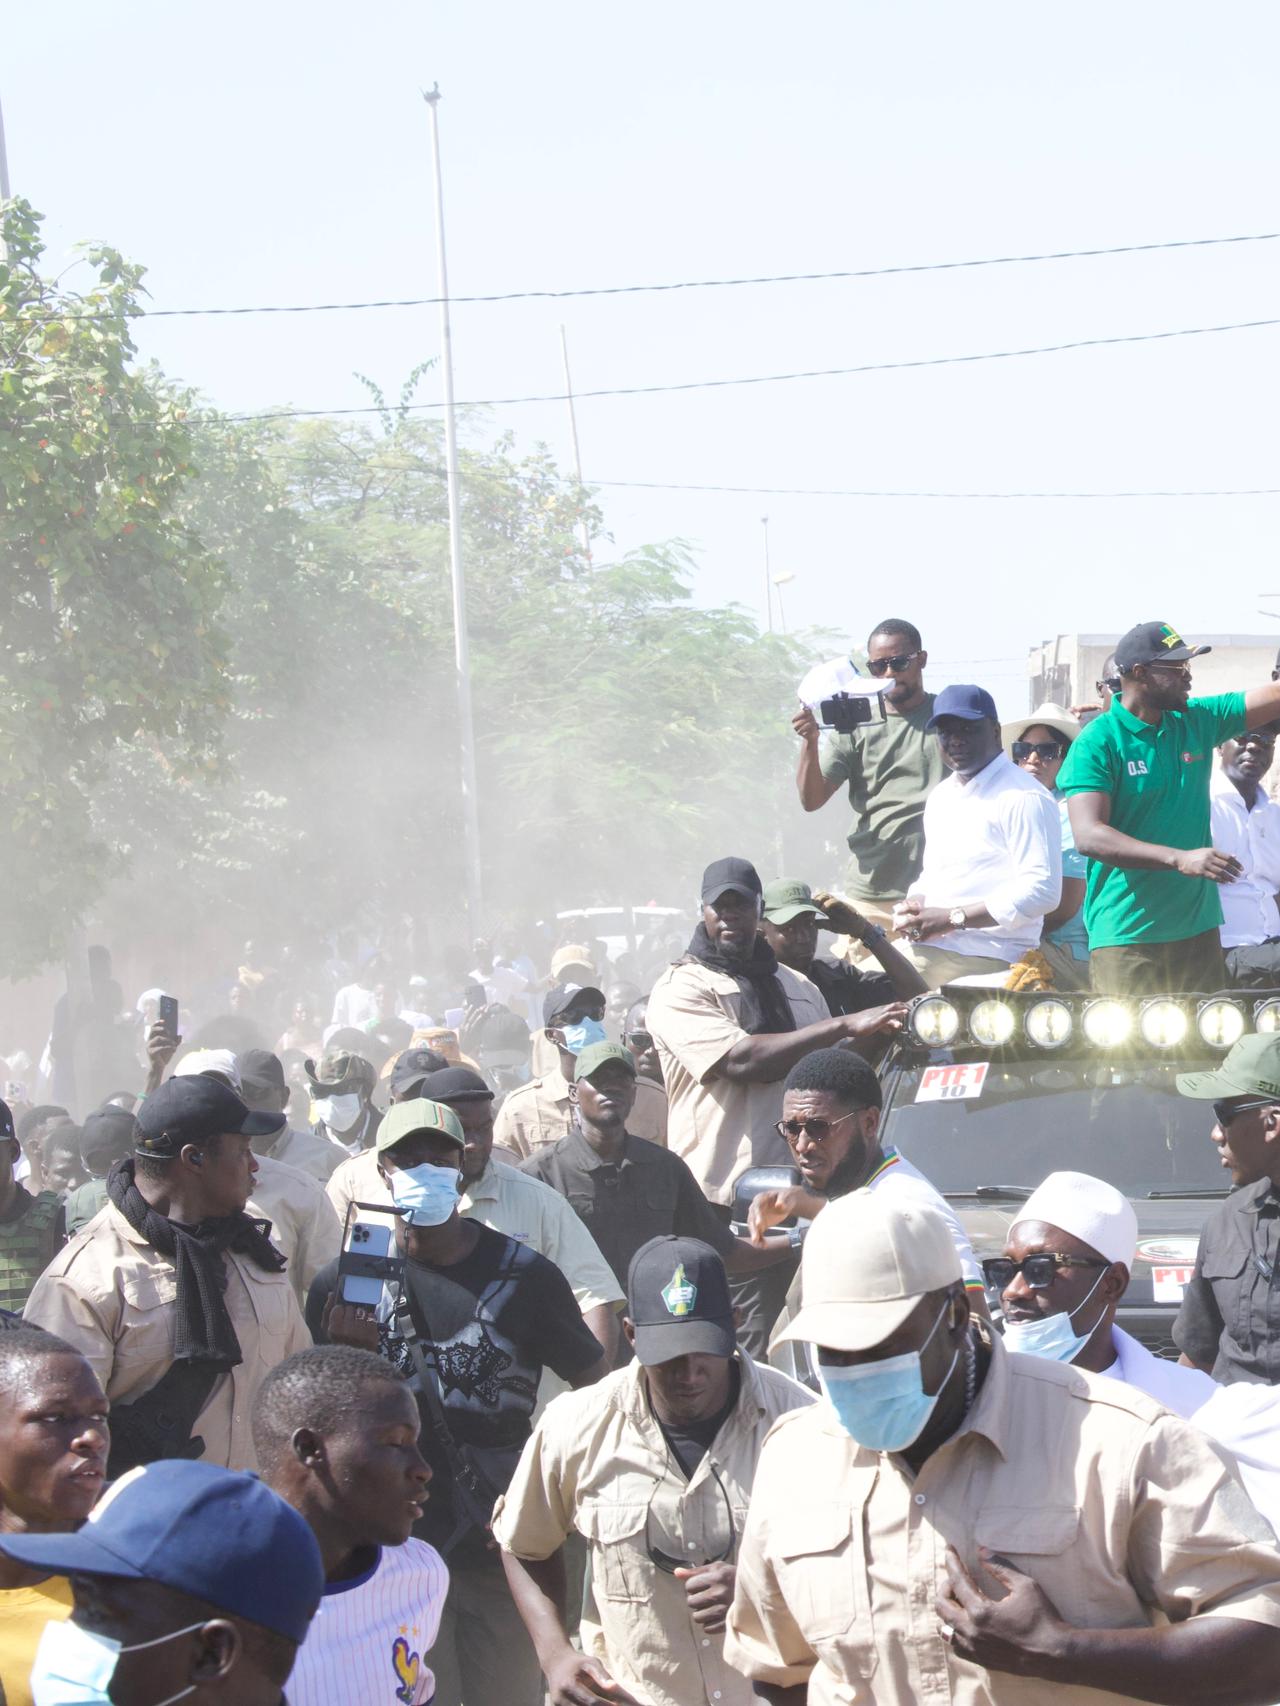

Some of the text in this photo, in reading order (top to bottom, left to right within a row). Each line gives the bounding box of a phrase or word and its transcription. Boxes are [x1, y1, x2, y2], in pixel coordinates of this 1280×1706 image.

[922, 1065, 985, 1088] PTF 1
[941, 1085, 967, 1097] 10
